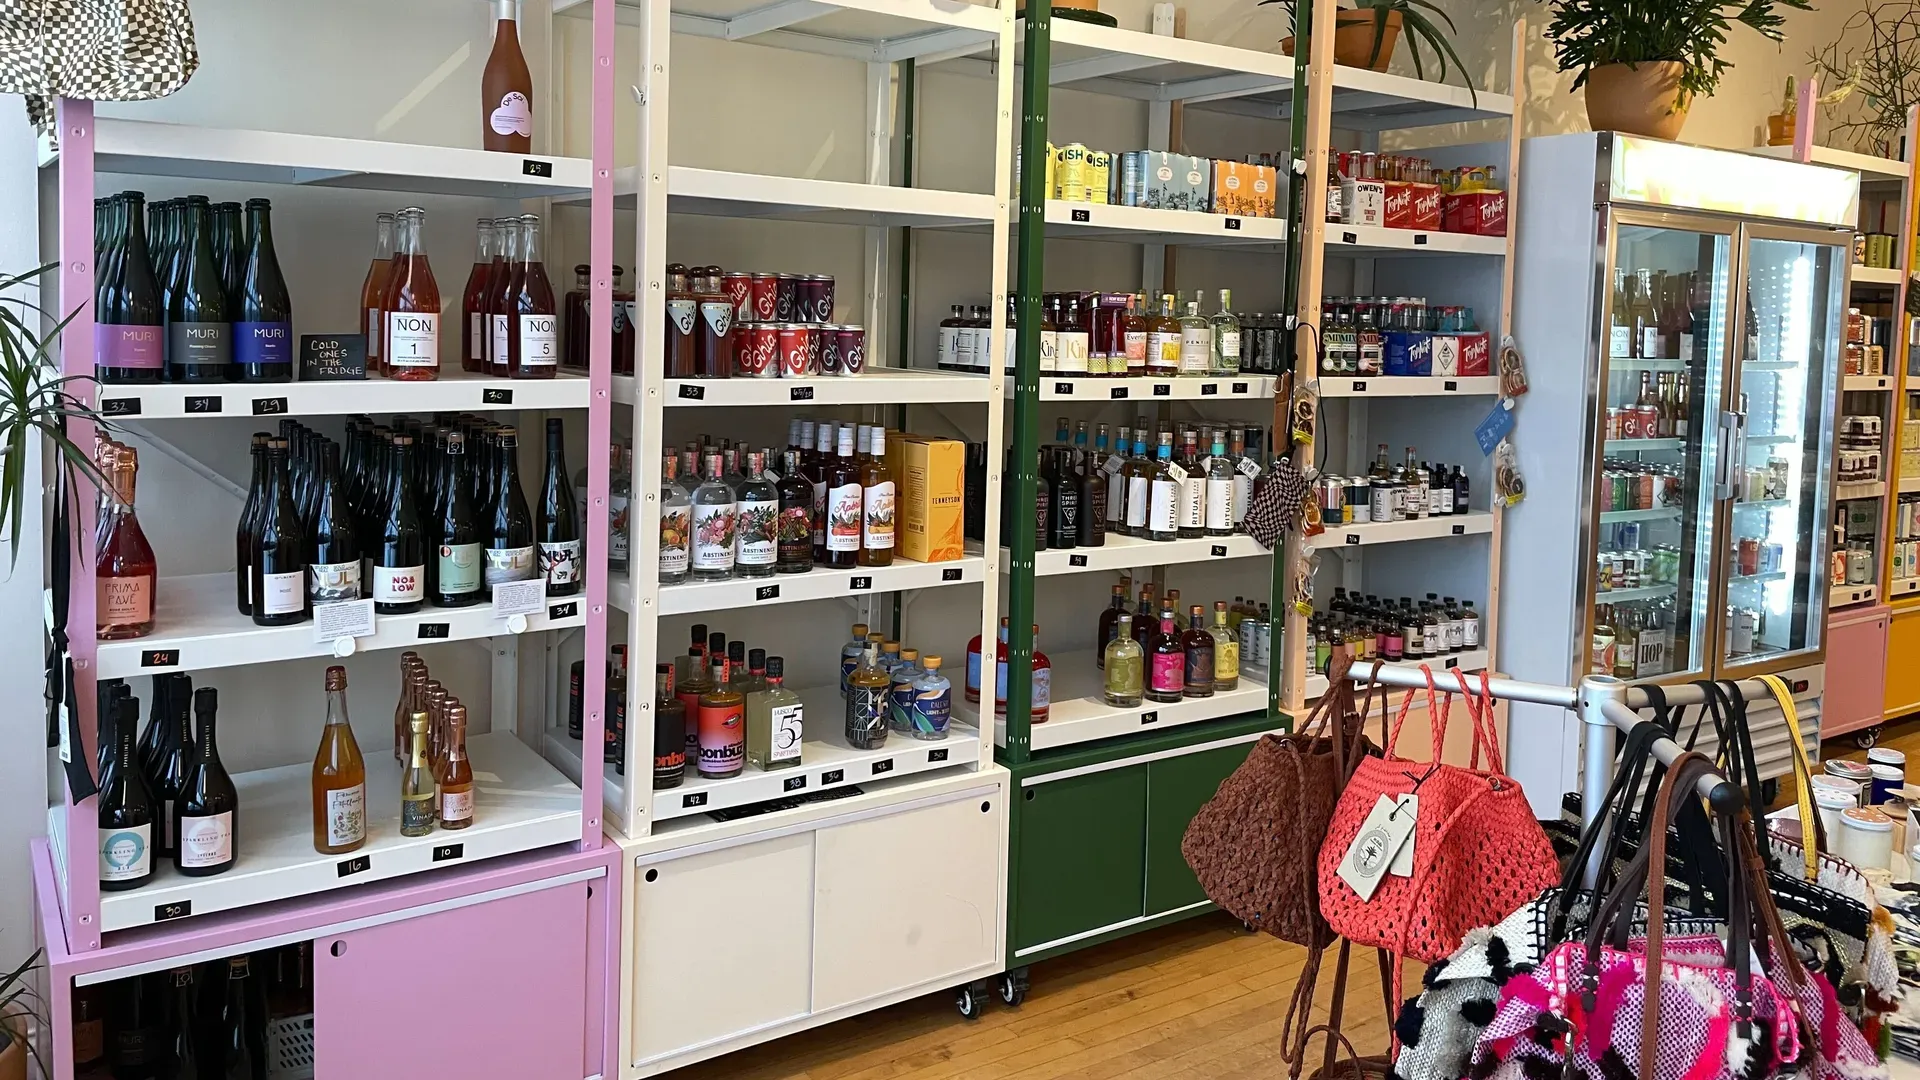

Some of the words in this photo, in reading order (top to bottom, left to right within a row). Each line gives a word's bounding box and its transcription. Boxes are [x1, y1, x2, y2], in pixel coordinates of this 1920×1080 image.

[1065, 149, 1083, 160] ISH
[728, 280, 747, 308] hia
[680, 304, 695, 331] Ghia
[397, 319, 432, 331] NON
[123, 331, 156, 342] MURI
[187, 329, 219, 340] MURI
[254, 328, 285, 339] MURI
[311, 339, 339, 351] COLD
[410, 343, 417, 355] 1
[543, 344, 550, 355] 5
[753, 333, 777, 369] Ghia
[319, 348, 348, 359] ONES
[306, 359, 317, 367] IN
[321, 358, 343, 367] THE
[319, 365, 363, 376] FRIDGE
[110, 401, 127, 412] 32
[194, 398, 209, 411] 34
[260, 399, 280, 412] 29
[932, 497, 960, 505] TENNEYSON
[1168, 500, 1176, 529] RITUAL
[1191, 496, 1199, 525] RITUAL
[1225, 496, 1233, 526] RITUAL
[104, 582, 140, 593] PRIMA
[392, 583, 415, 592] LOW
[556, 605, 570, 616] 34
[427, 625, 438, 637] 24
[153, 652, 169, 664] 24
[700, 743, 743, 759] bonbuz
[690, 795, 701, 804] 42
[441, 848, 451, 857] 10
[348, 860, 361, 872] 16
[166, 905, 181, 917] 30
